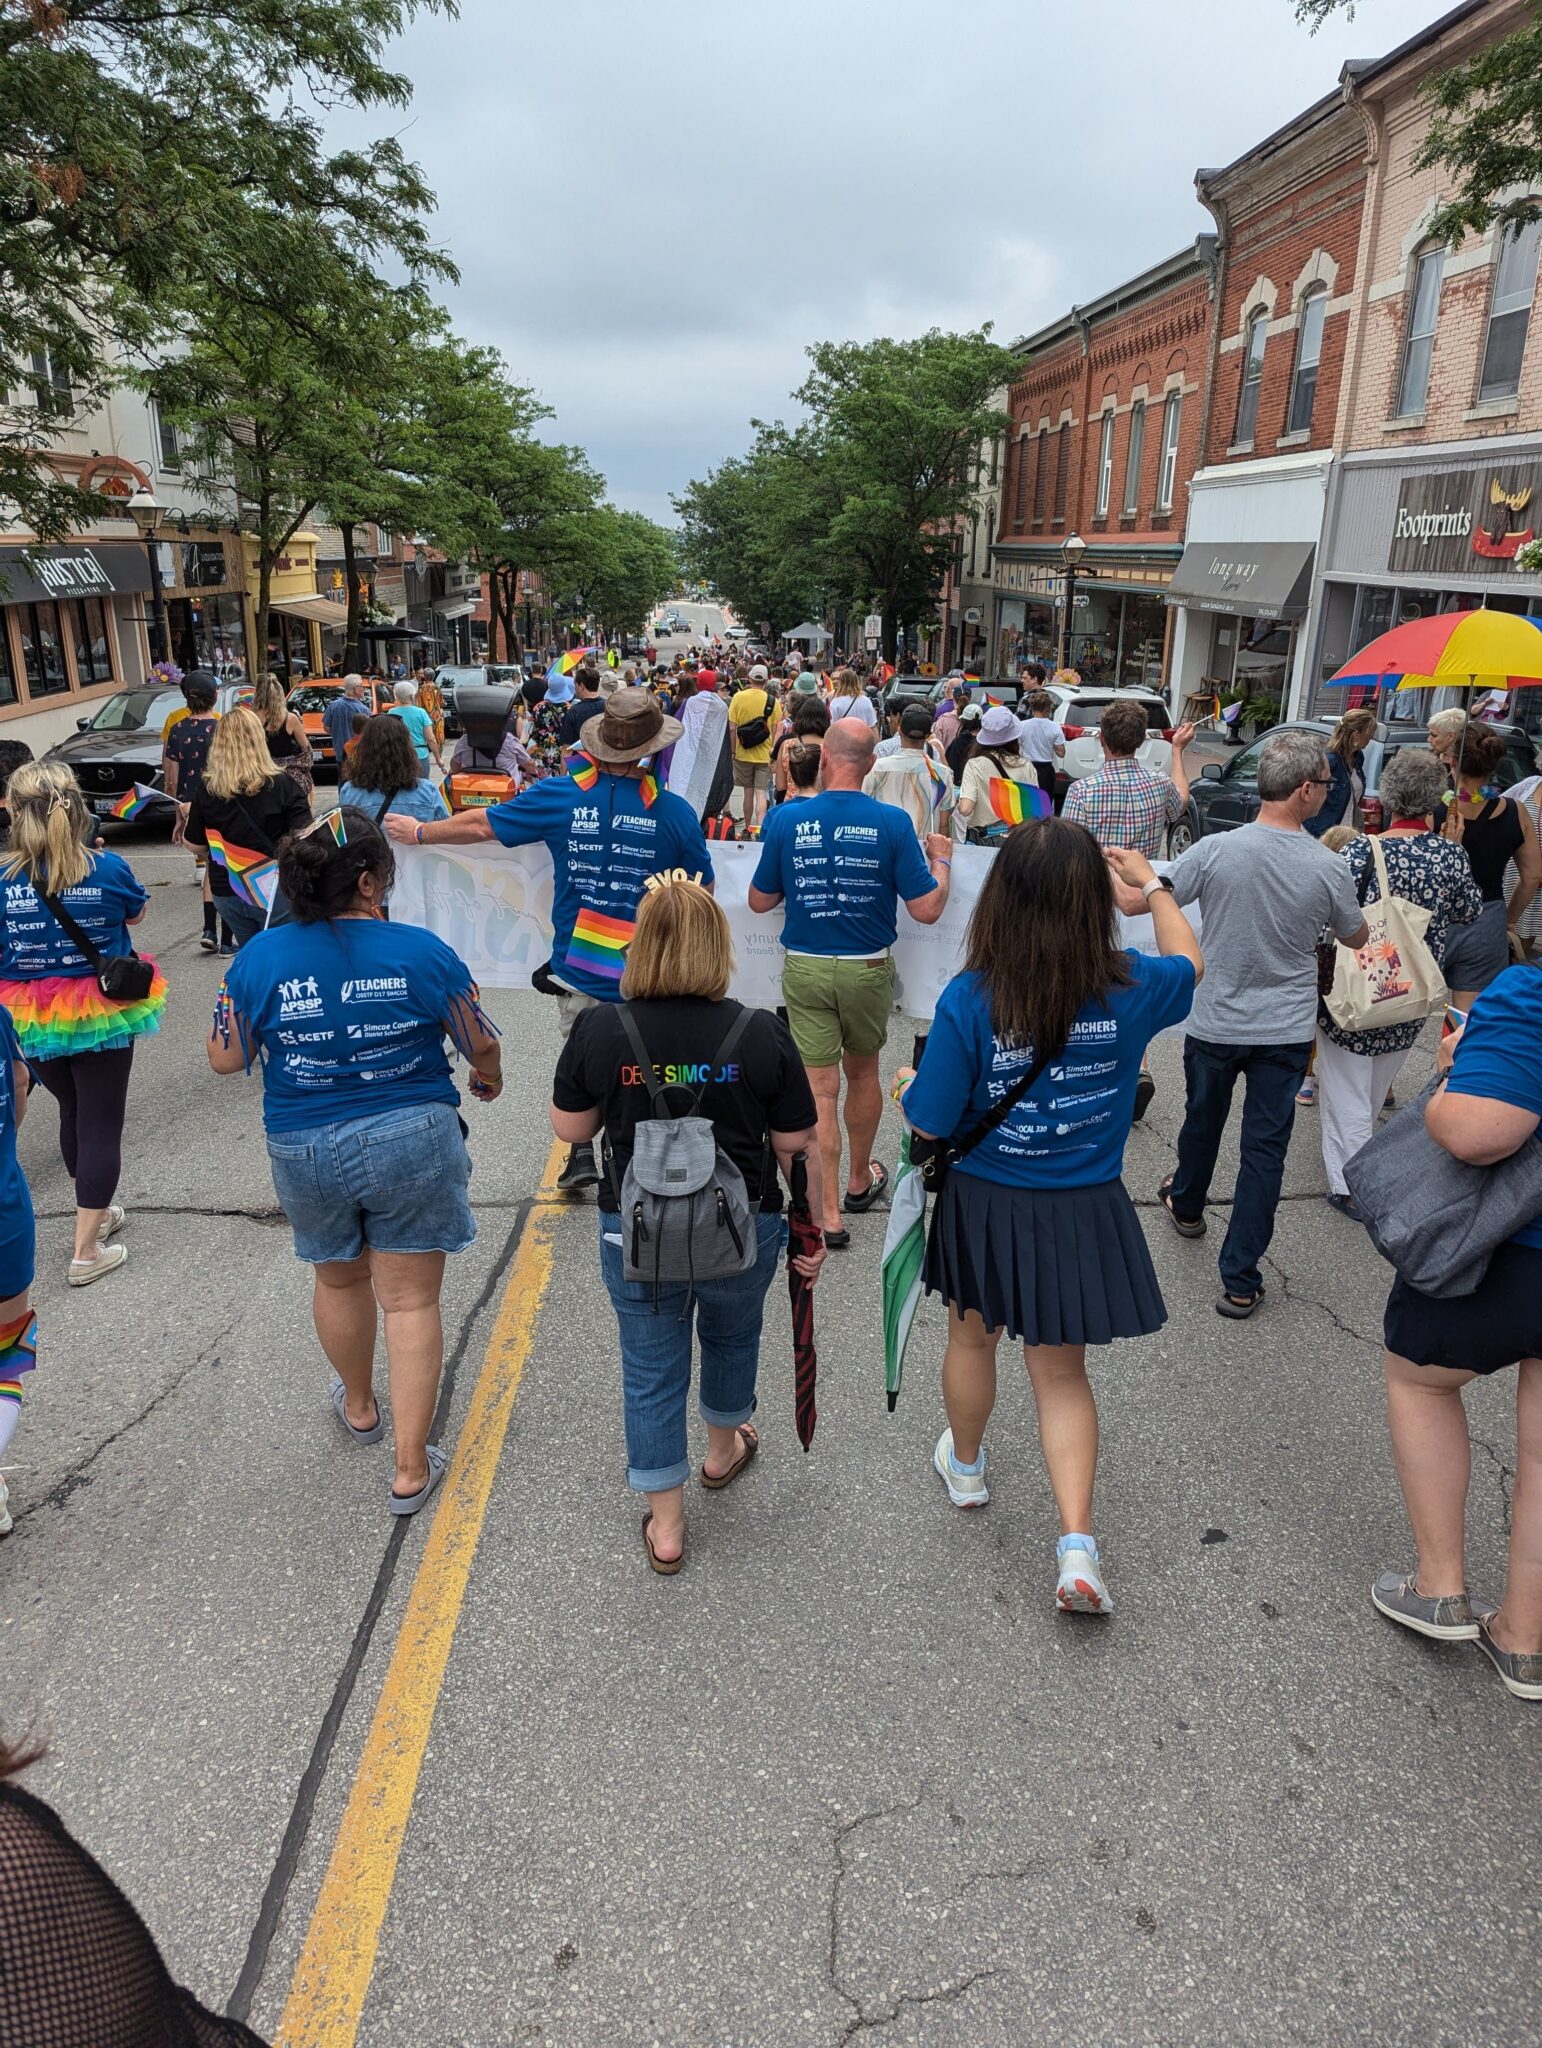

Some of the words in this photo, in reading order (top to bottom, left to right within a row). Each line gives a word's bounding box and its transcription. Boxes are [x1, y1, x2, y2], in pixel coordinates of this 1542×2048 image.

[1395, 504, 1472, 545] Footprints
[34, 557, 106, 587] RUSTICA
[1208, 556, 1234, 581] long
[1235, 563, 1260, 582] way
[571, 820, 600, 829] APSSP
[622, 815, 657, 828] TEACHERS
[843, 825, 878, 837] TEACHERS
[795, 834, 823, 844] APSSP
[578, 844, 604, 852] SCETF
[804, 857, 828, 865] SCETF
[63, 887, 103, 897] TEACHERS
[5, 898, 39, 909] APSSP
[18, 921, 47, 931] SCETF
[1377, 918, 1388, 928] OF
[354, 977, 408, 992] TEACHERS
[355, 991, 374, 999] OSSTF
[386, 989, 408, 997] SIMCOE
[280, 997, 323, 1014] APSSP
[363, 1023, 391, 1032] Simcoe
[392, 1019, 419, 1029] County
[1068, 1019, 1118, 1035] EACHERS
[297, 1030, 335, 1042] SCETF
[364, 1030, 383, 1038] District
[1094, 1032, 1118, 1040] SIMCOE
[992, 1045, 1034, 1064] APSSP
[1065, 1064, 1093, 1073] Simcoe
[1093, 1059, 1119, 1071] County
[1014, 1100, 1039, 1110] cipals'
[1016, 1124, 1035, 1134] LOCAL
[1035, 1125, 1048, 1133] 330
